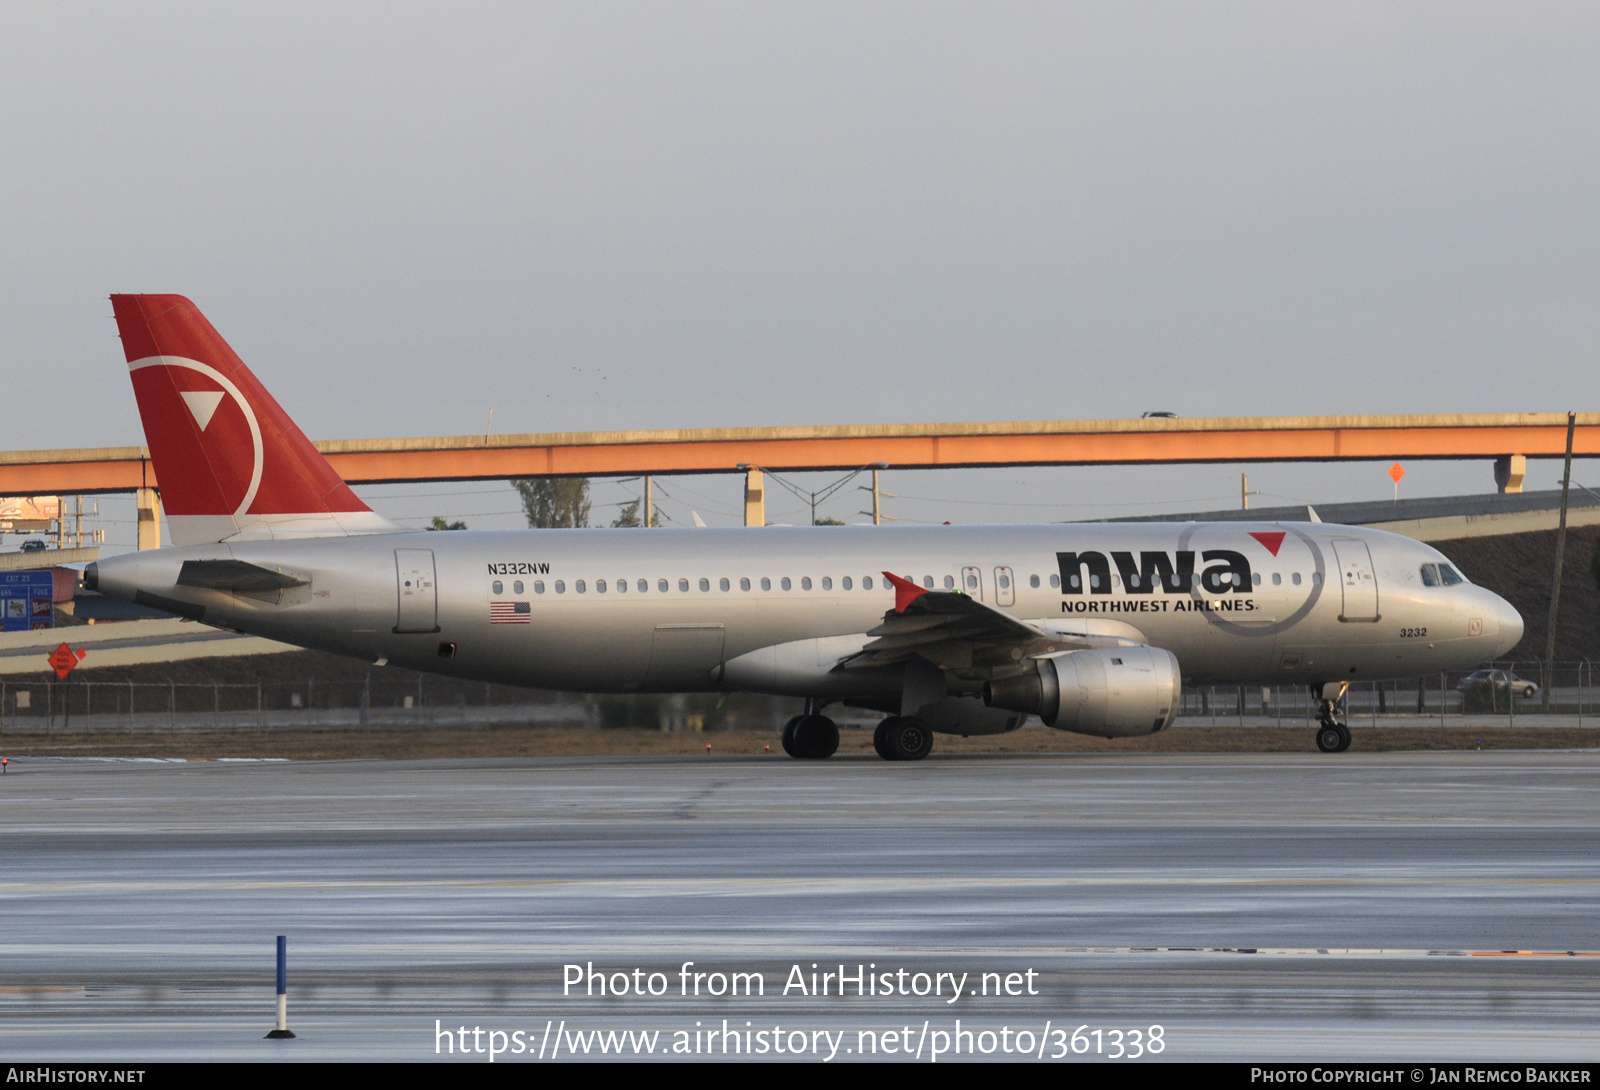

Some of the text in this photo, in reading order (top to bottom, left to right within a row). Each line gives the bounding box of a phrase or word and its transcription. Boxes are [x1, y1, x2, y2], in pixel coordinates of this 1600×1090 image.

[488, 563, 550, 575] N332NW
[1056, 550, 1253, 594] nwa
[1061, 600, 1170, 613] NORTHWEST
[1400, 627, 1427, 638] 3232
